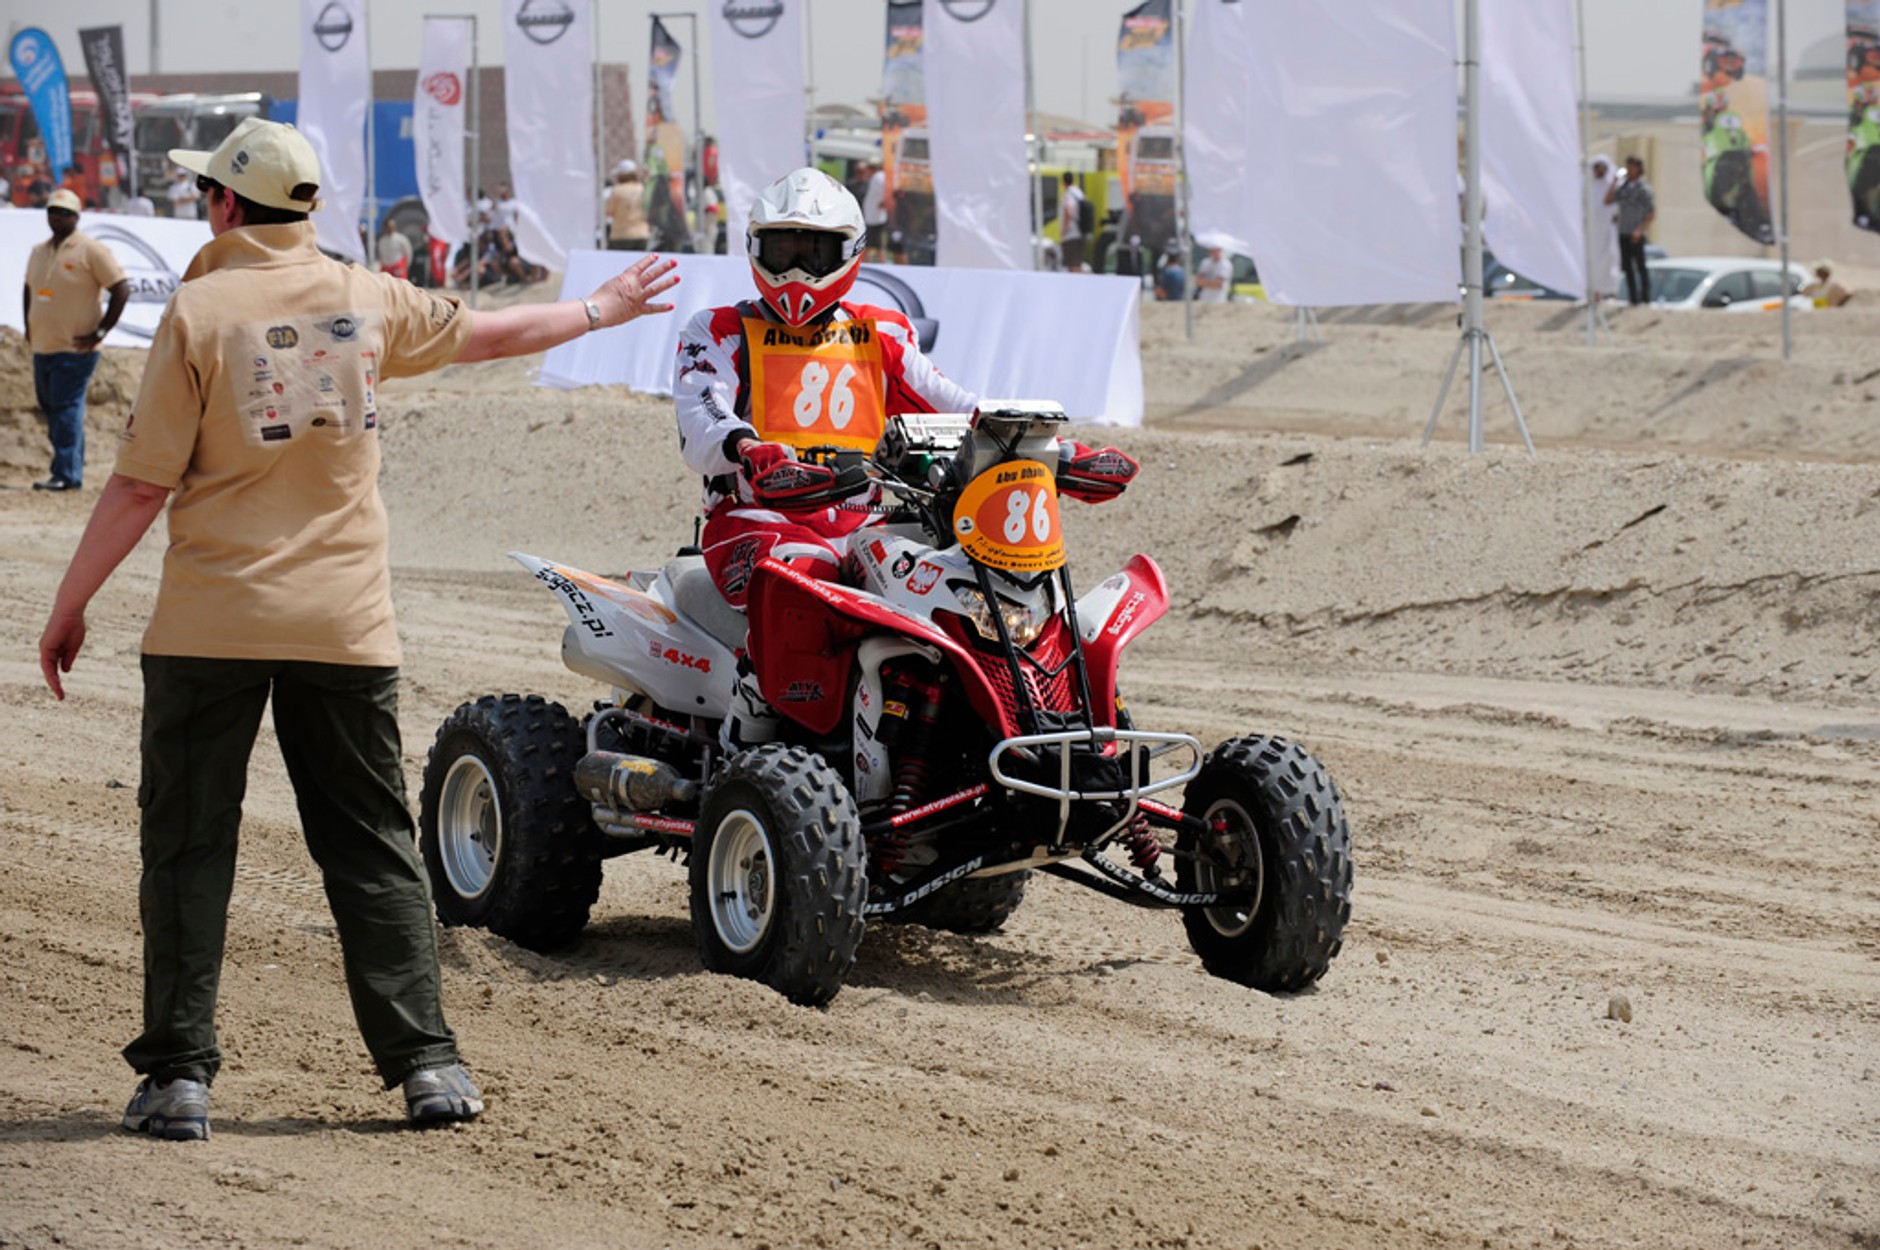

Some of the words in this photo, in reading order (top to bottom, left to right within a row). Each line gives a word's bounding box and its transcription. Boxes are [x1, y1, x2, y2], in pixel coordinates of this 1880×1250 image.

[267, 331, 296, 346] FIA
[763, 328, 804, 346] Abu
[793, 361, 856, 430] 86
[995, 471, 1018, 484] Abu
[1003, 488, 1050, 544] 86
[663, 648, 712, 674] 4x4
[894, 783, 987, 824] www.atvpolska.pl
[902, 856, 983, 907] DESIGN
[1139, 880, 1218, 905] DESIGN
